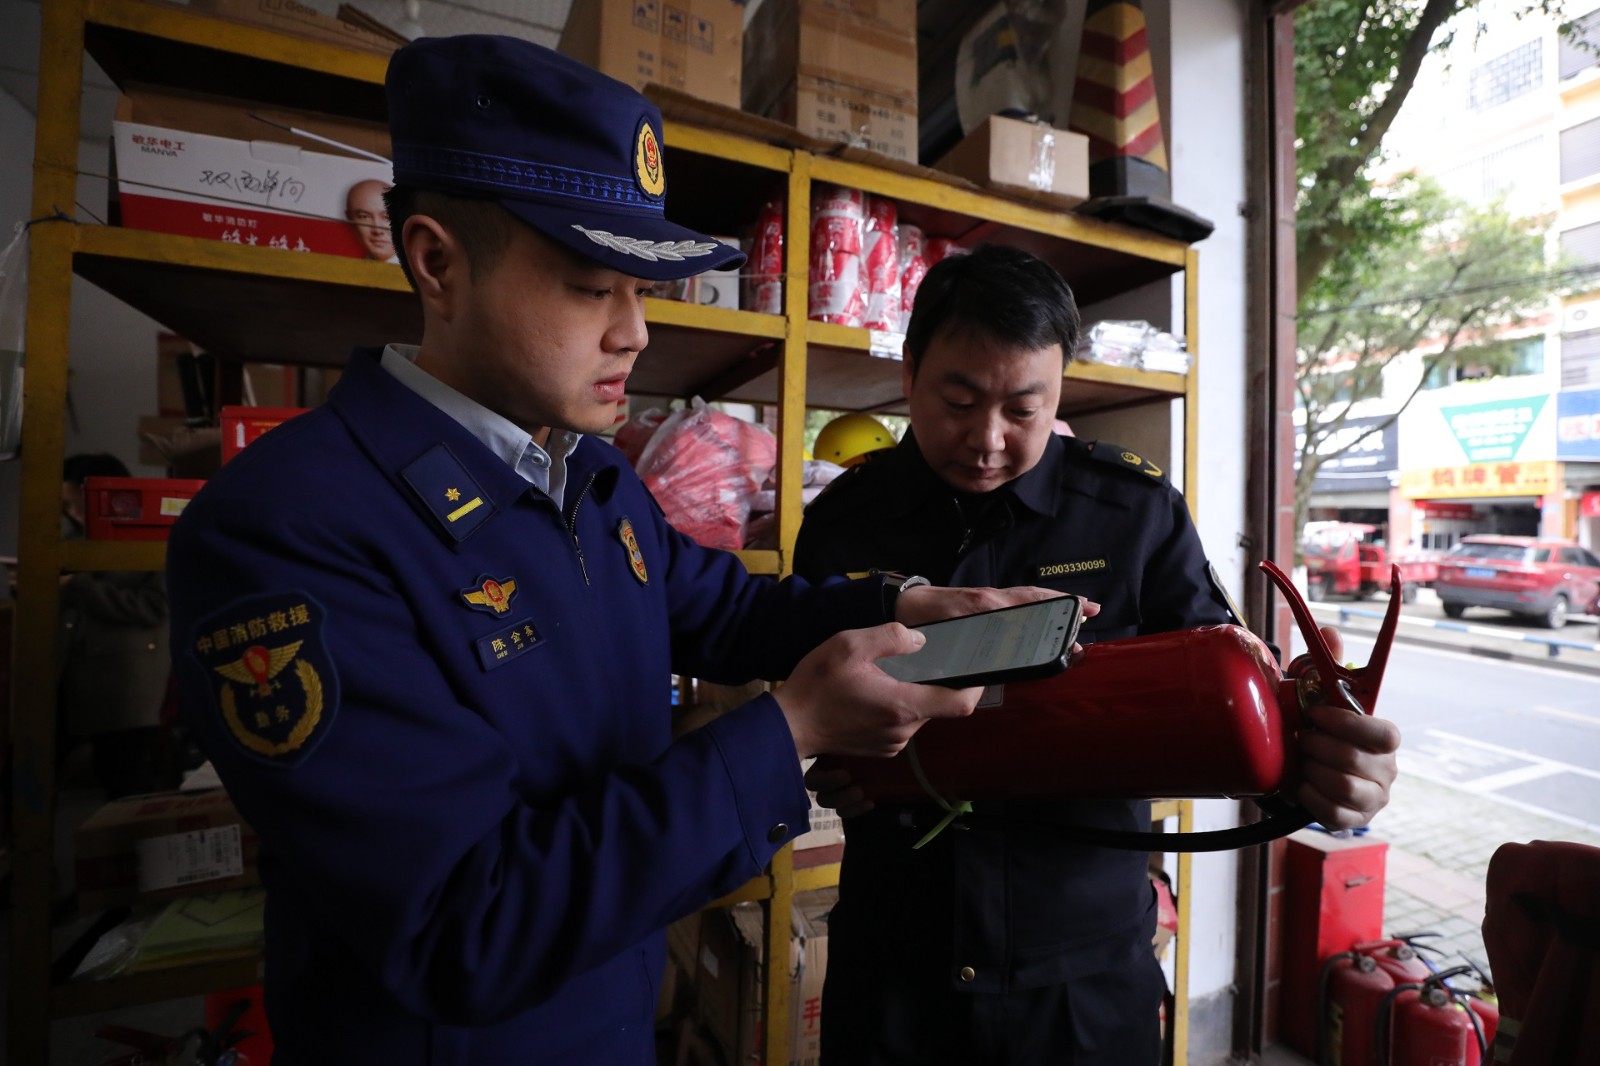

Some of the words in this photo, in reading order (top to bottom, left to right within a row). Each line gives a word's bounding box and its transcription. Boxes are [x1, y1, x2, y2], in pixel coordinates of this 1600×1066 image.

[132, 134, 186, 152] 敏华电工
[141, 146, 177, 158] MANVA
[1040, 559, 1106, 576] 22003330099
[197, 603, 311, 655] 中国消防救援
[803, 995, 821, 1029] 手
